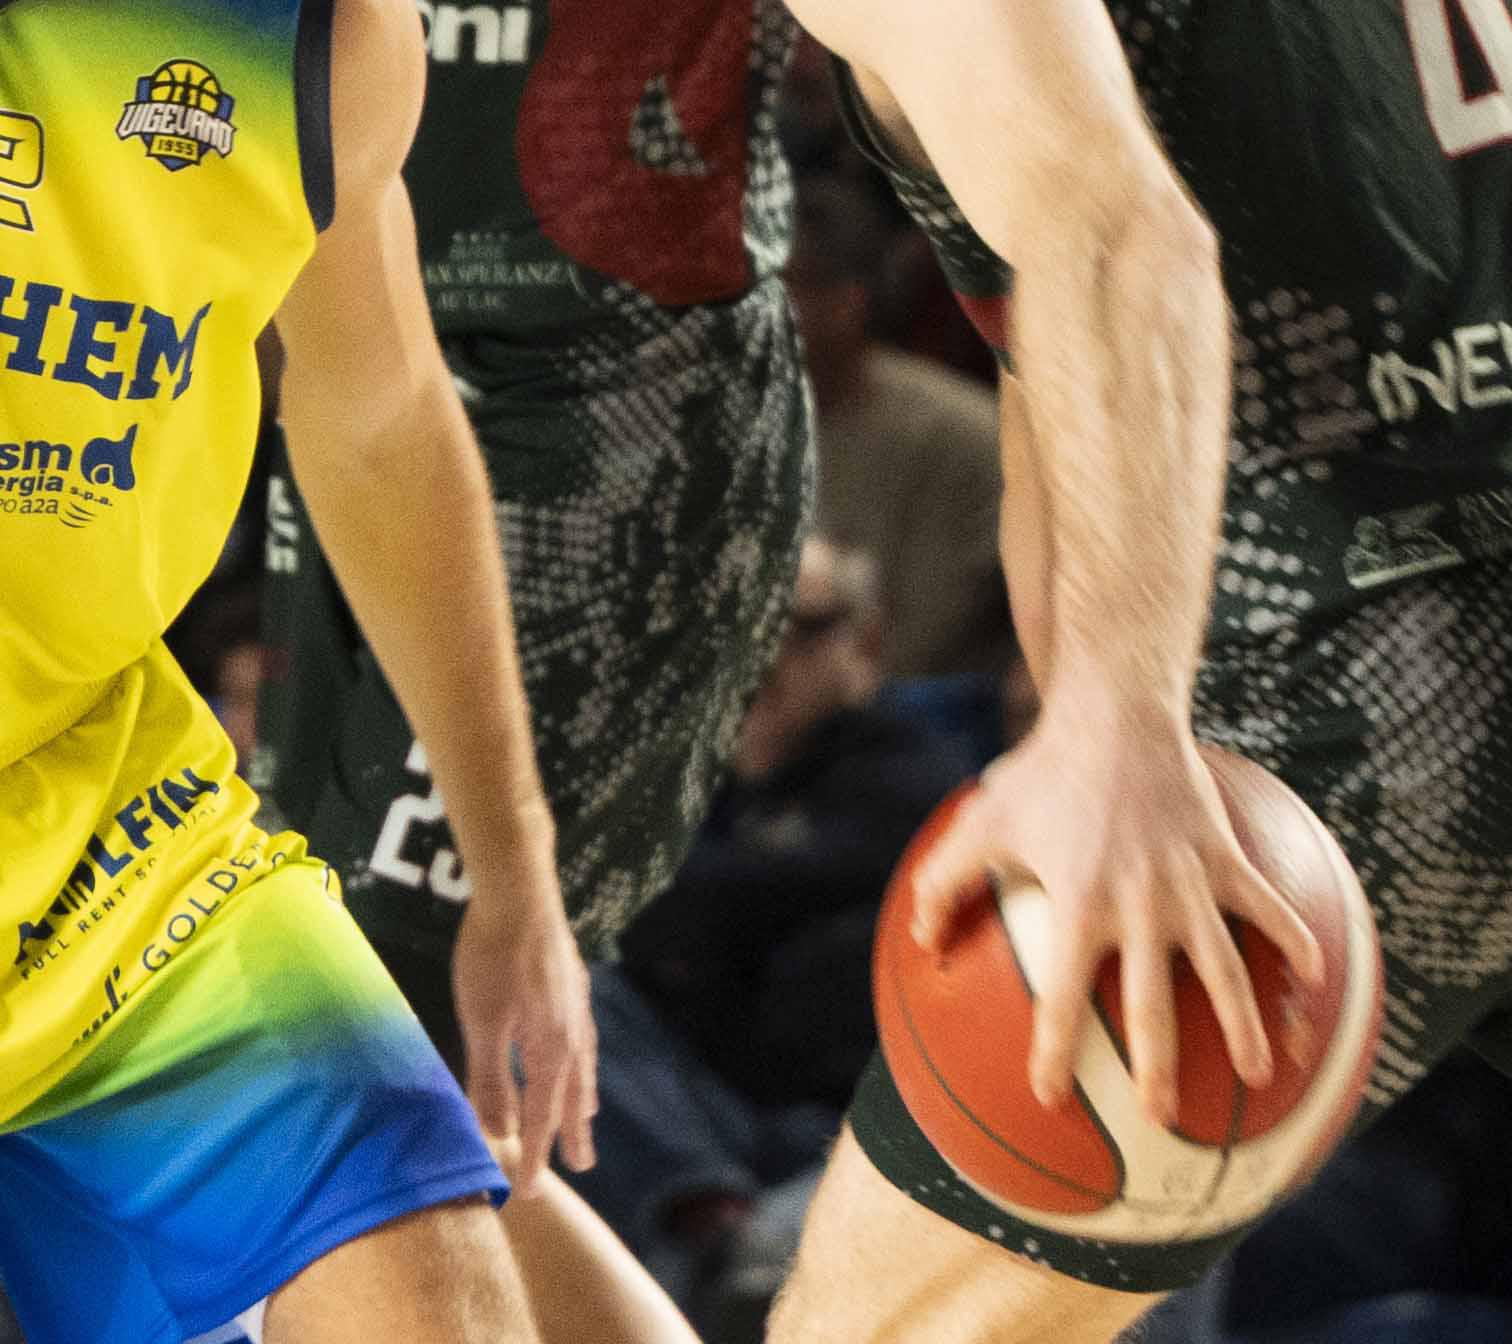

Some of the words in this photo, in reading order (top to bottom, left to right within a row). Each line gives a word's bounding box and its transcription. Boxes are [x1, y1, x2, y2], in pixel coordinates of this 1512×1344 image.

[119, 102, 235, 154] VIGEVANO
[158, 139, 195, 155] 1955
[19, 498, 59, 514] a2a
[78, 887, 128, 933] RENT
